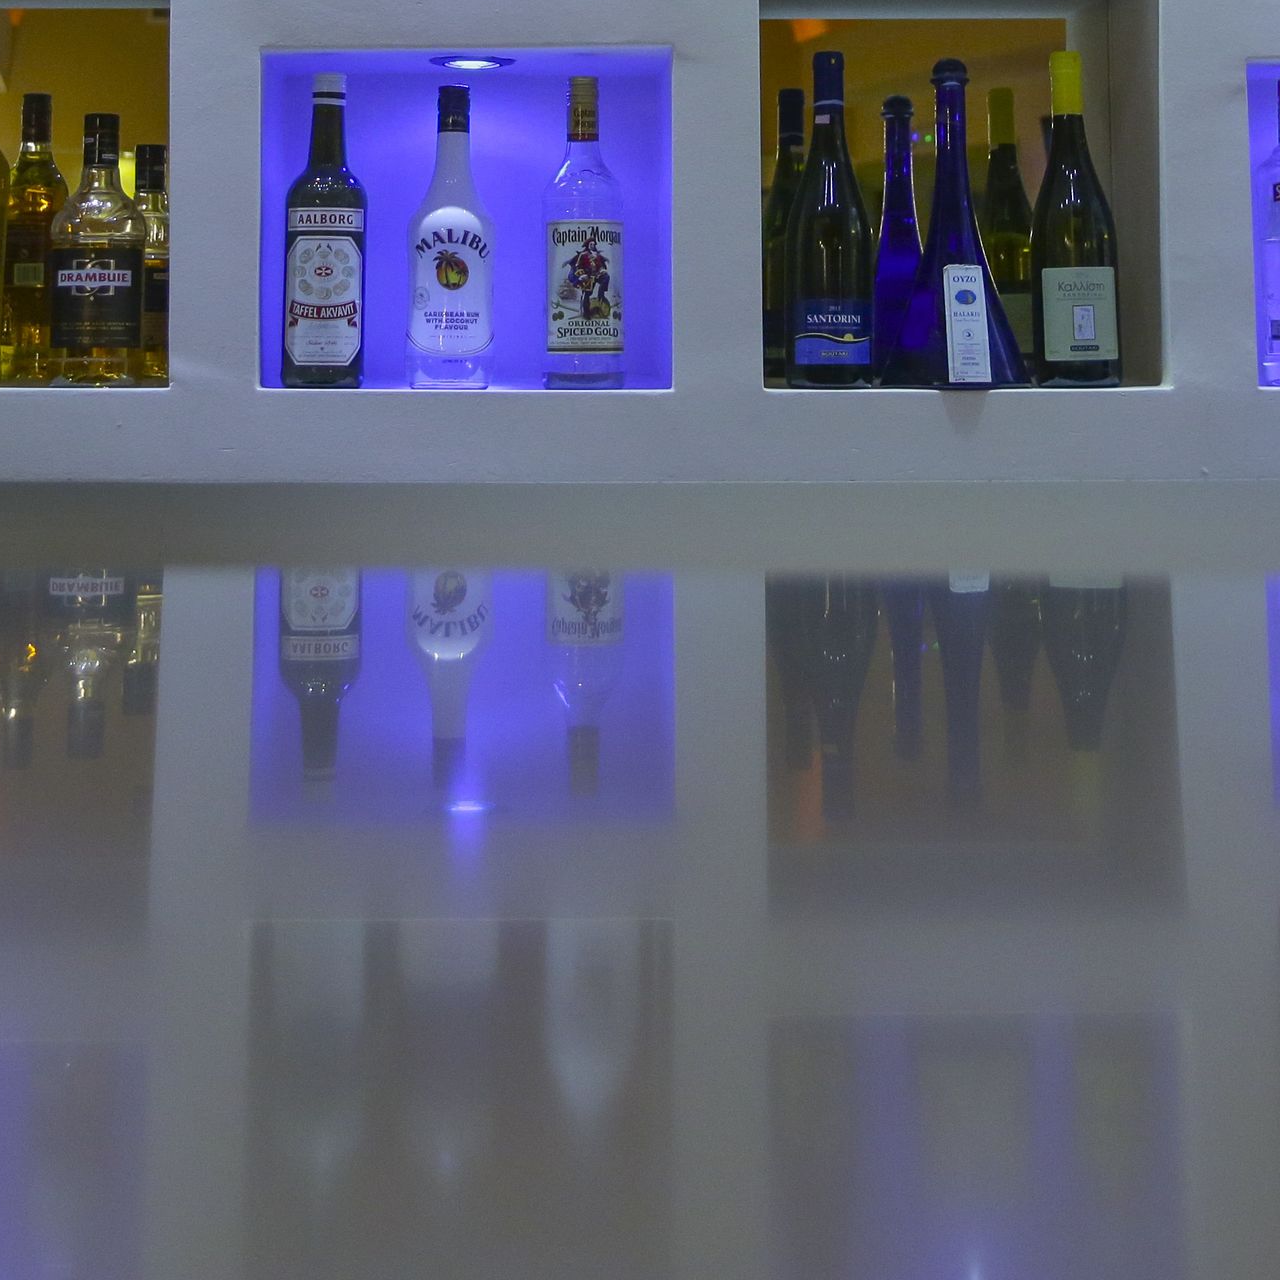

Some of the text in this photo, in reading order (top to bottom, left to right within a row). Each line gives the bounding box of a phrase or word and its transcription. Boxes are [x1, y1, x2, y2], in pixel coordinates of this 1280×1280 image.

[298, 213, 354, 225] AALBORG
[552, 227, 587, 246] Captain
[415, 228, 490, 259] MALIBU
[60, 272, 129, 282] DRAMBUIE
[292, 303, 355, 318] TAFFEL AKVAVIT
[806, 314, 861, 324] SANTORINI
[557, 327, 619, 338] SPICED GOLD
